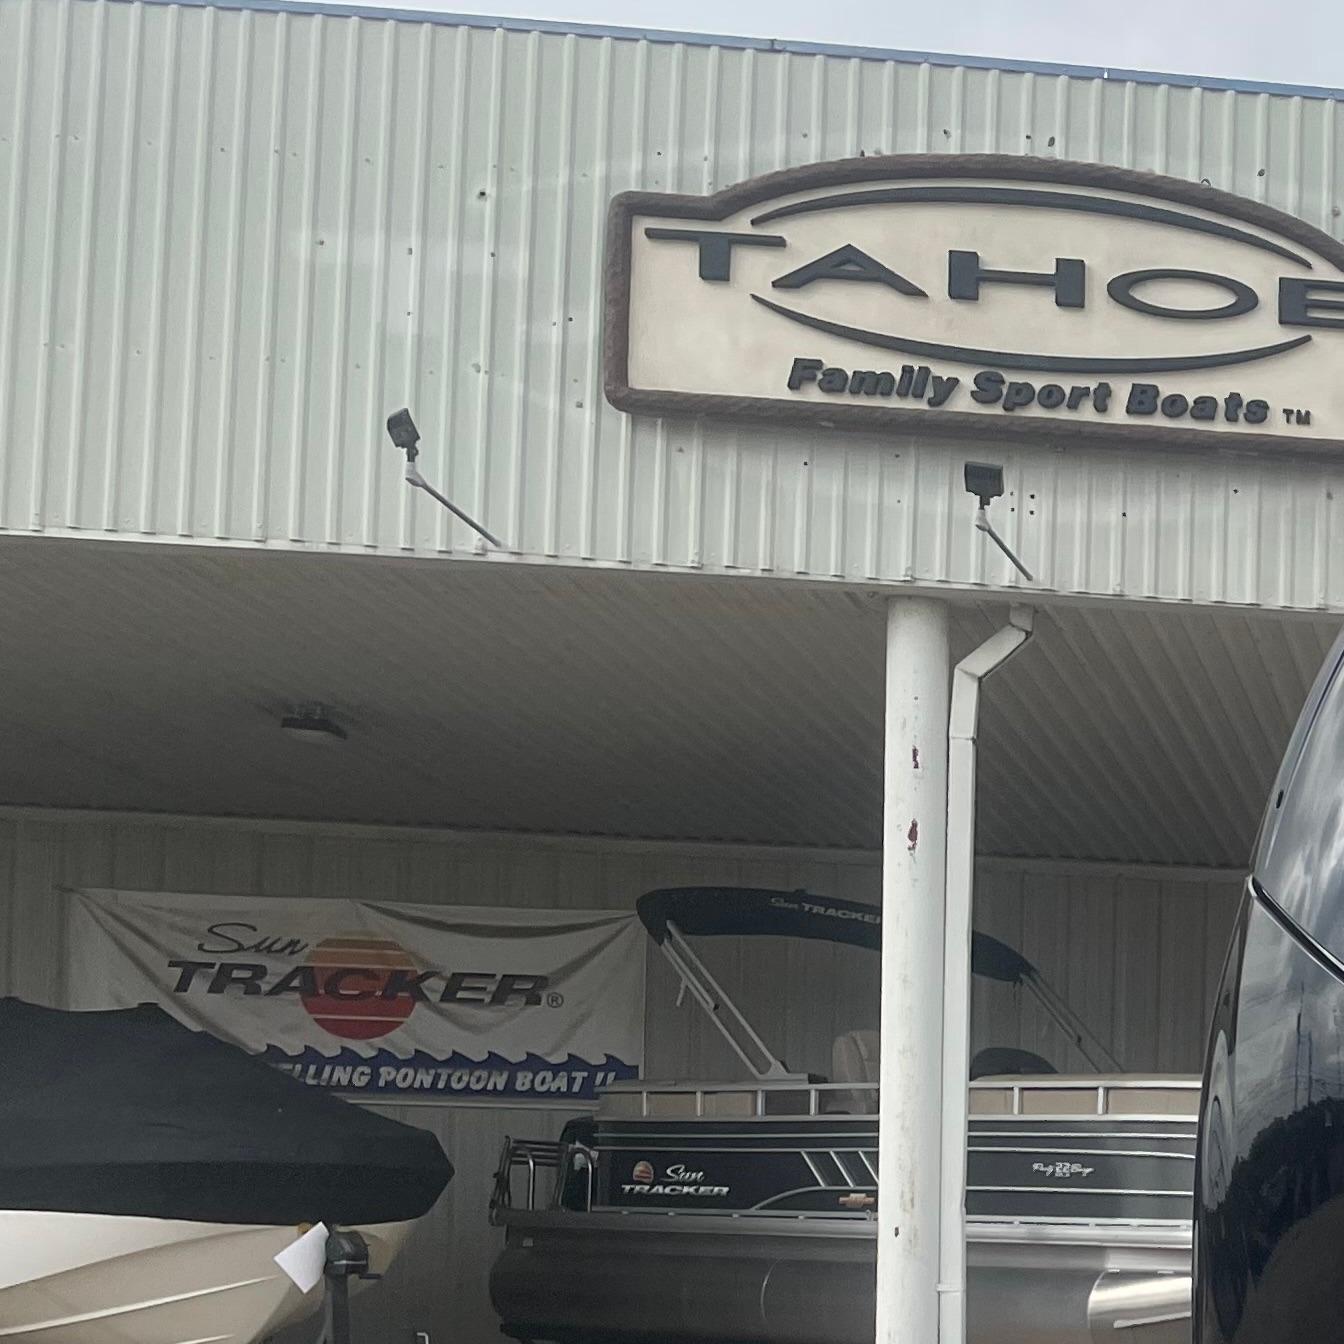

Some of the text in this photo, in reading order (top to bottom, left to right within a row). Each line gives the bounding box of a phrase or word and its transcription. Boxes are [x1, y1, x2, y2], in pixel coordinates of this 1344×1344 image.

[787, 357, 959, 407] Family
[971, 371, 1112, 413] Sport
[1126, 383, 1270, 424] Boats
[196, 922, 308, 956] Sun
[276, 1063, 372, 1088] LLING
[379, 1066, 509, 1090] PONTOON
[515, 1070, 588, 1094] BOAT
[660, 1164, 705, 1181] Sun
[621, 1184, 730, 1196] TRACKER
